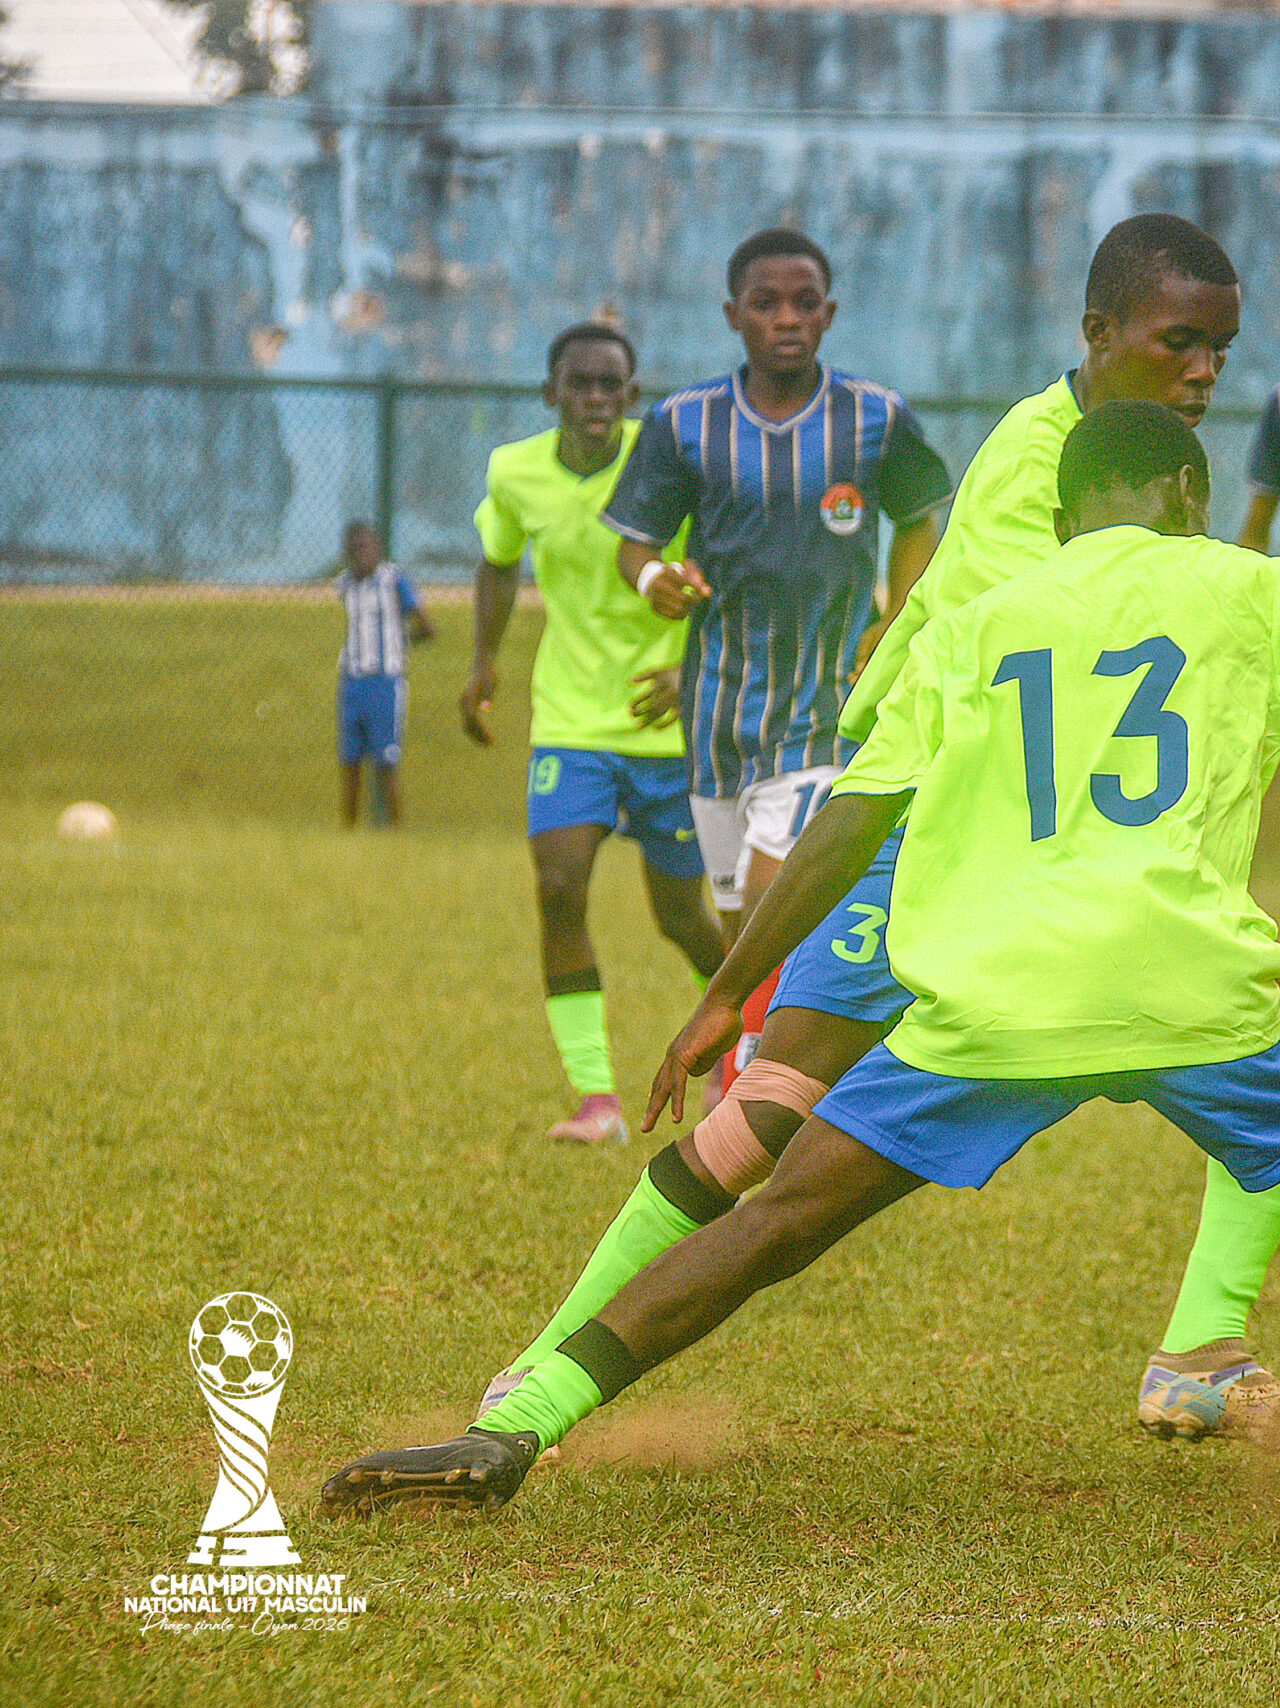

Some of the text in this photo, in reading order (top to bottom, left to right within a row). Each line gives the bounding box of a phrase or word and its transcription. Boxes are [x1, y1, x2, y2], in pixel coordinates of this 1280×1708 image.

[990, 634, 1189, 842] 13
[794, 780, 833, 837] 1
[831, 902, 888, 964] 3
